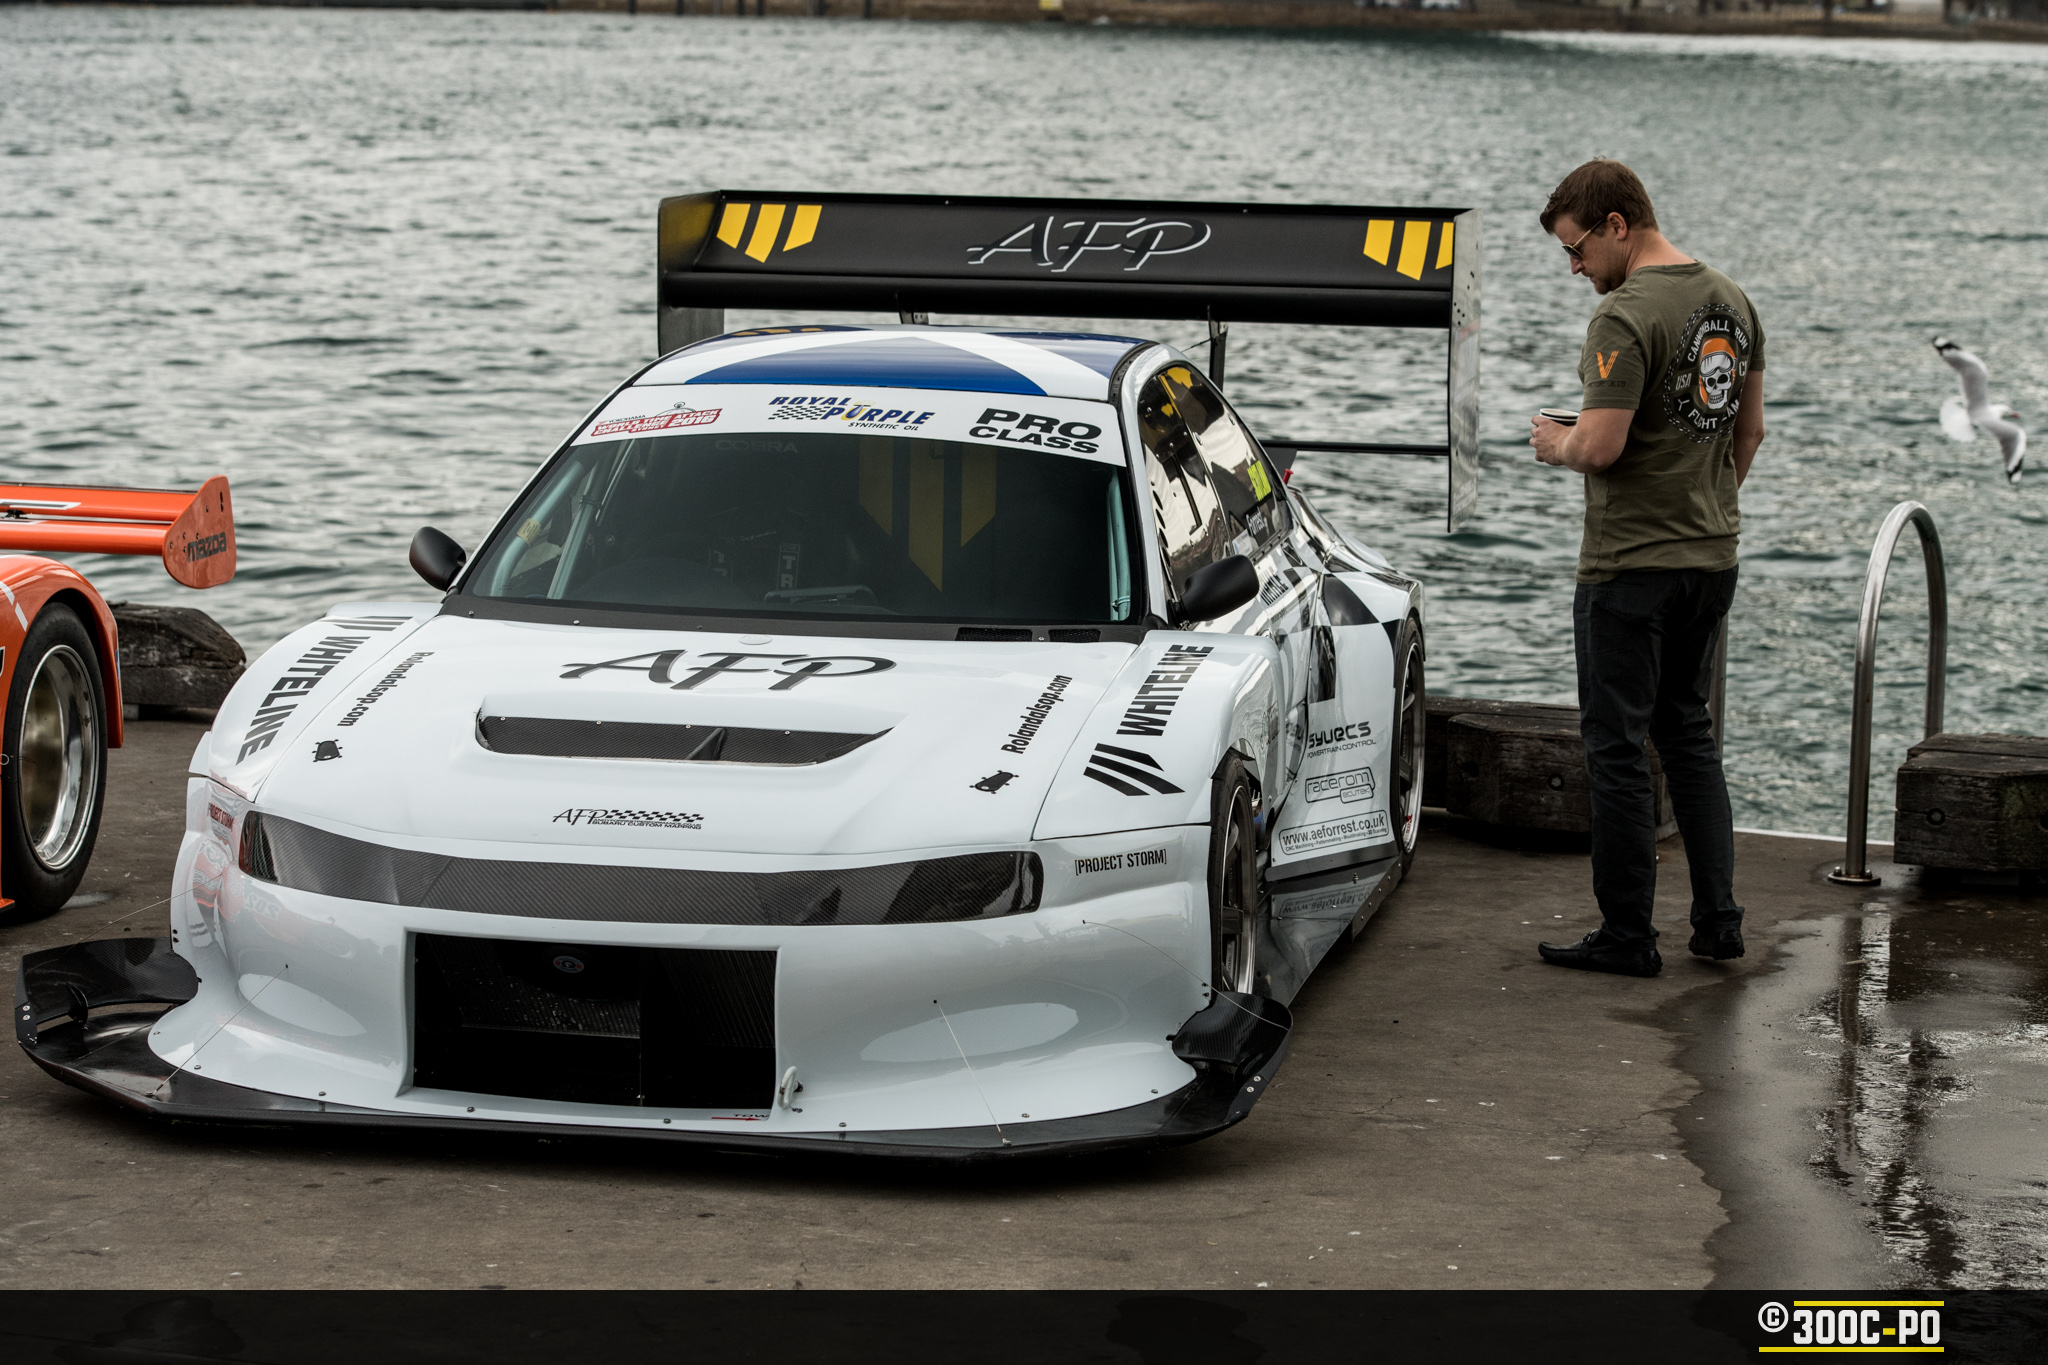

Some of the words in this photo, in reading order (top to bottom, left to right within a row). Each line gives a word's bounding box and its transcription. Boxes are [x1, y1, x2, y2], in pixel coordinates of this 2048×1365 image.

[966, 215, 1212, 273] AFP
[1734, 326, 1749, 350] RUN
[1675, 373, 1692, 391] USA
[768, 396, 851, 405] ROYAL
[597, 420, 641, 431] WORLD
[675, 409, 719, 419] ATTACK
[820, 404, 936, 425] PURPLE
[848, 421, 899, 430] SYNTHETIC
[976, 408, 1102, 440] PRO
[715, 439, 800, 454] COBRA
[968, 425, 1100, 453] CLASS
[558, 648, 898, 691] AFP
[236, 636, 371, 766] WHITELINE
[1116, 644, 1215, 736] WHITELINE
[1000, 674, 1073, 754] Rolandalsop.com
[1307, 745, 1342, 759] POWERTRAIN
[1342, 738, 1377, 751] CONTROL
[552, 808, 608, 826] AFP
[1282, 813, 1385, 846] www.aeforrest.co.uk
